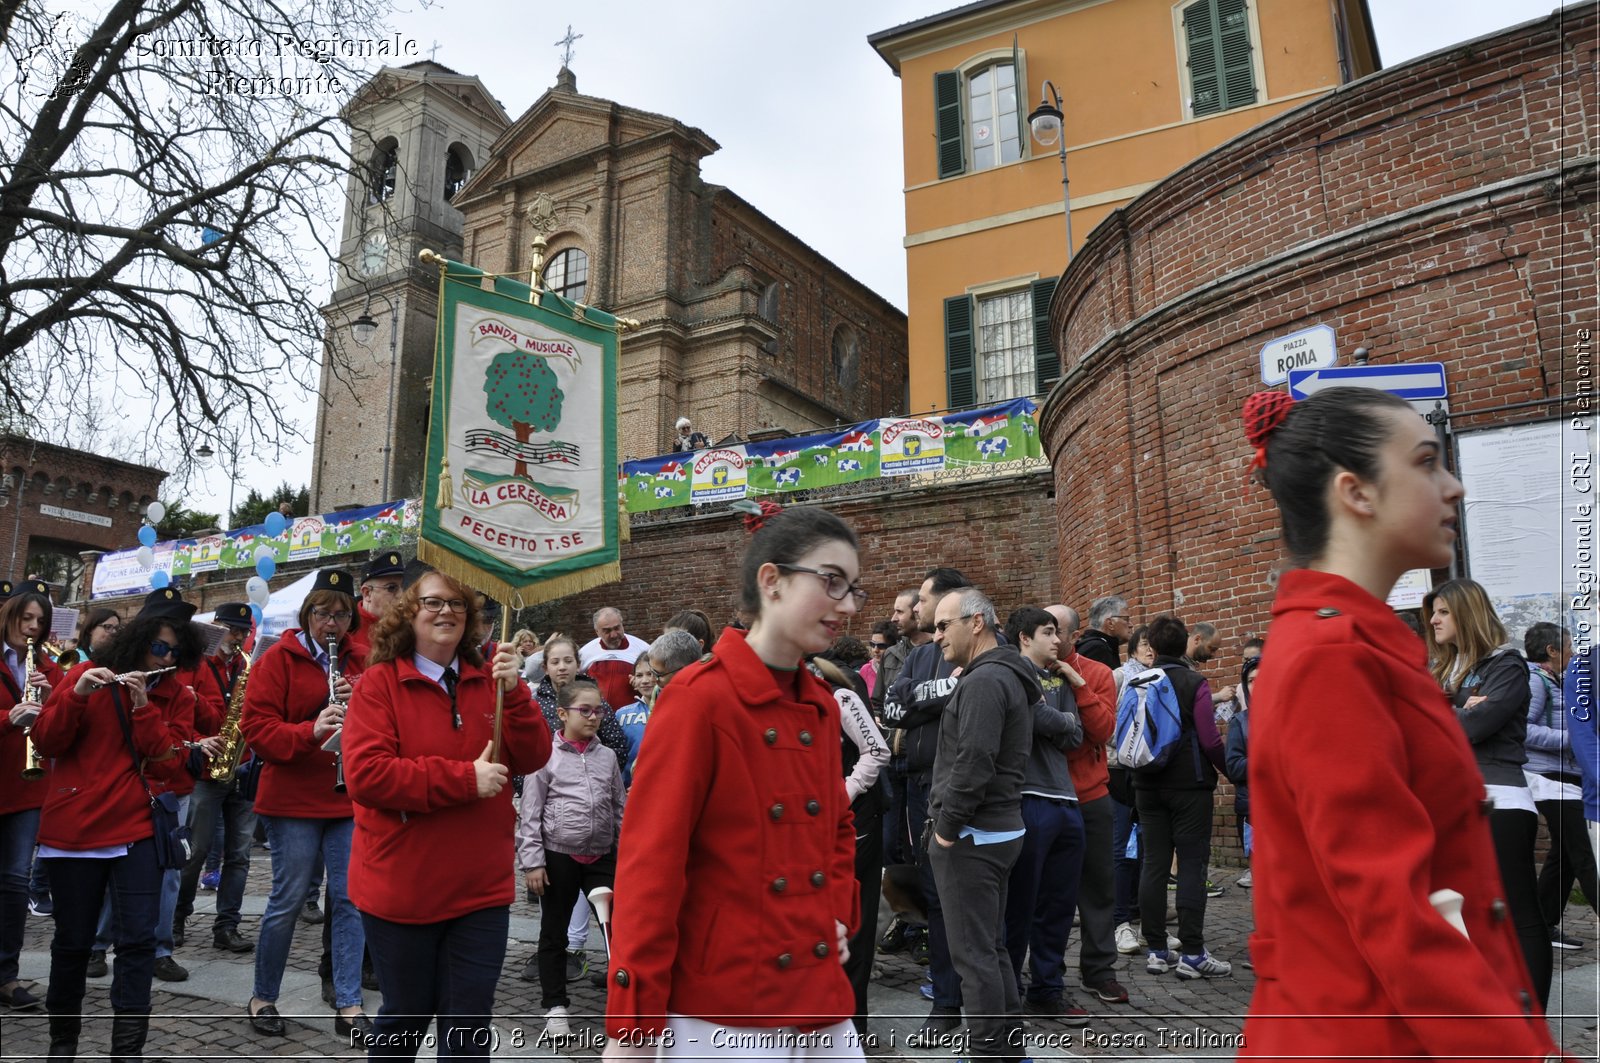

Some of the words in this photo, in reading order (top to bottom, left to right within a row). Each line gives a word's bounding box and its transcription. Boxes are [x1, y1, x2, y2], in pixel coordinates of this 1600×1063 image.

[478, 323, 518, 344] BANDA
[526, 338, 573, 357] MUSICALE
[1284, 338, 1308, 352] PIAZZA
[1278, 349, 1318, 374] ROMA
[471, 490, 490, 505] LA
[497, 484, 566, 520] CERESERA
[460, 516, 537, 552] PECETTO
